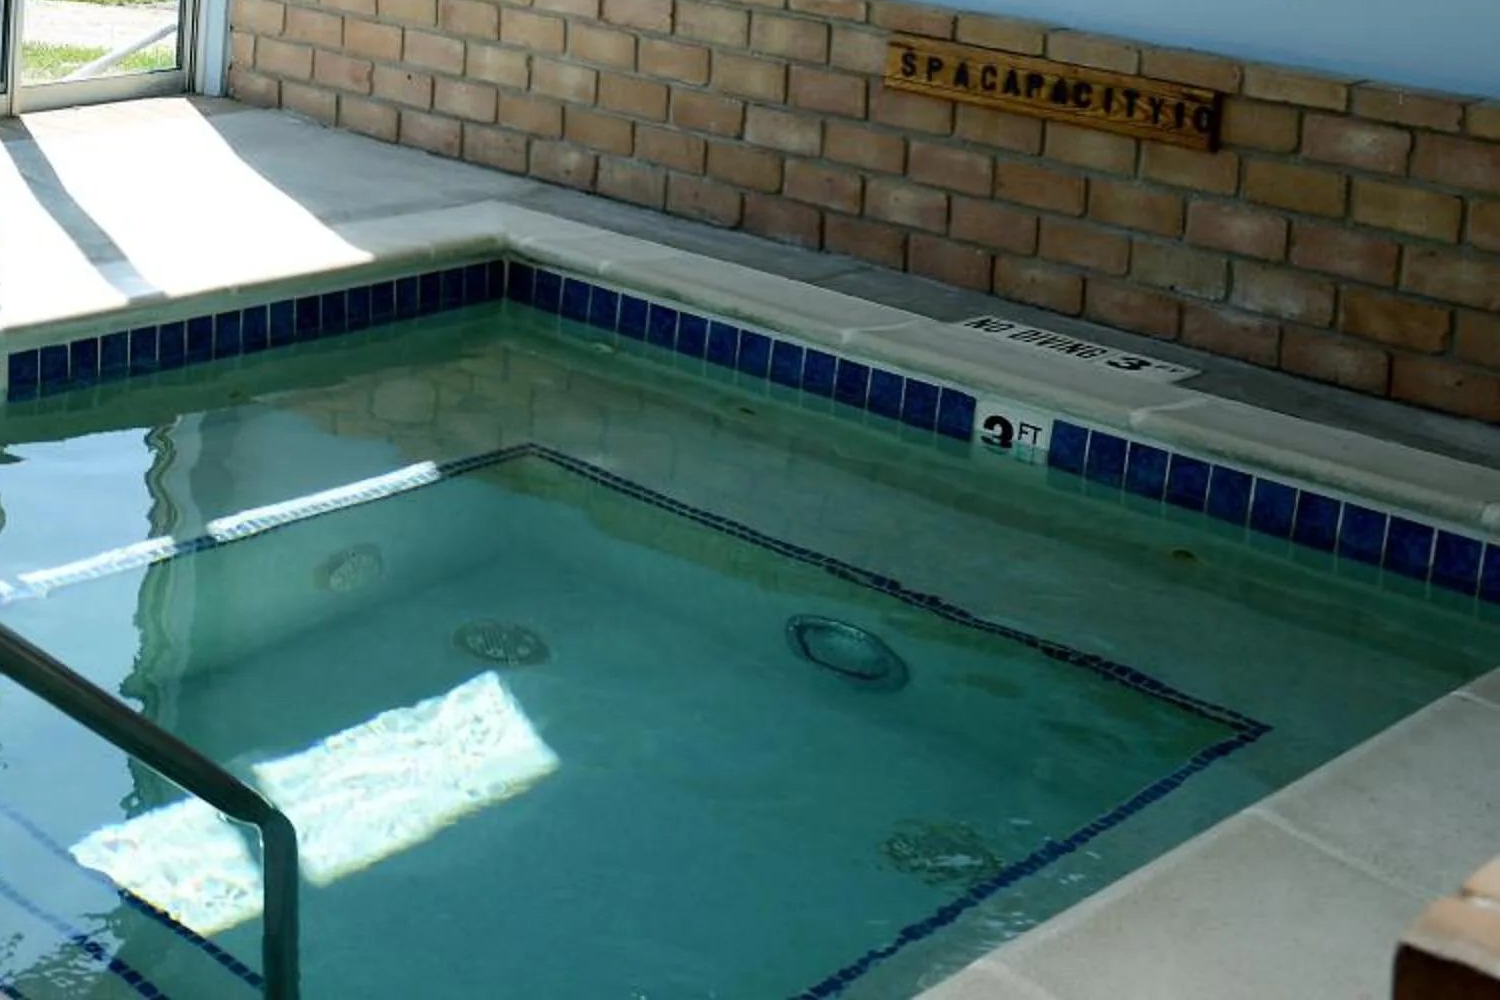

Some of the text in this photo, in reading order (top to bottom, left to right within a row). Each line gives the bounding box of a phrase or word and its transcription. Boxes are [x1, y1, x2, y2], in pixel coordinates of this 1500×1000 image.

[965, 318, 1013, 333] NO
[1009, 329, 1107, 359] DIVING
[1106, 356, 1151, 371] 3
[981, 415, 1043, 449] 3 FT
